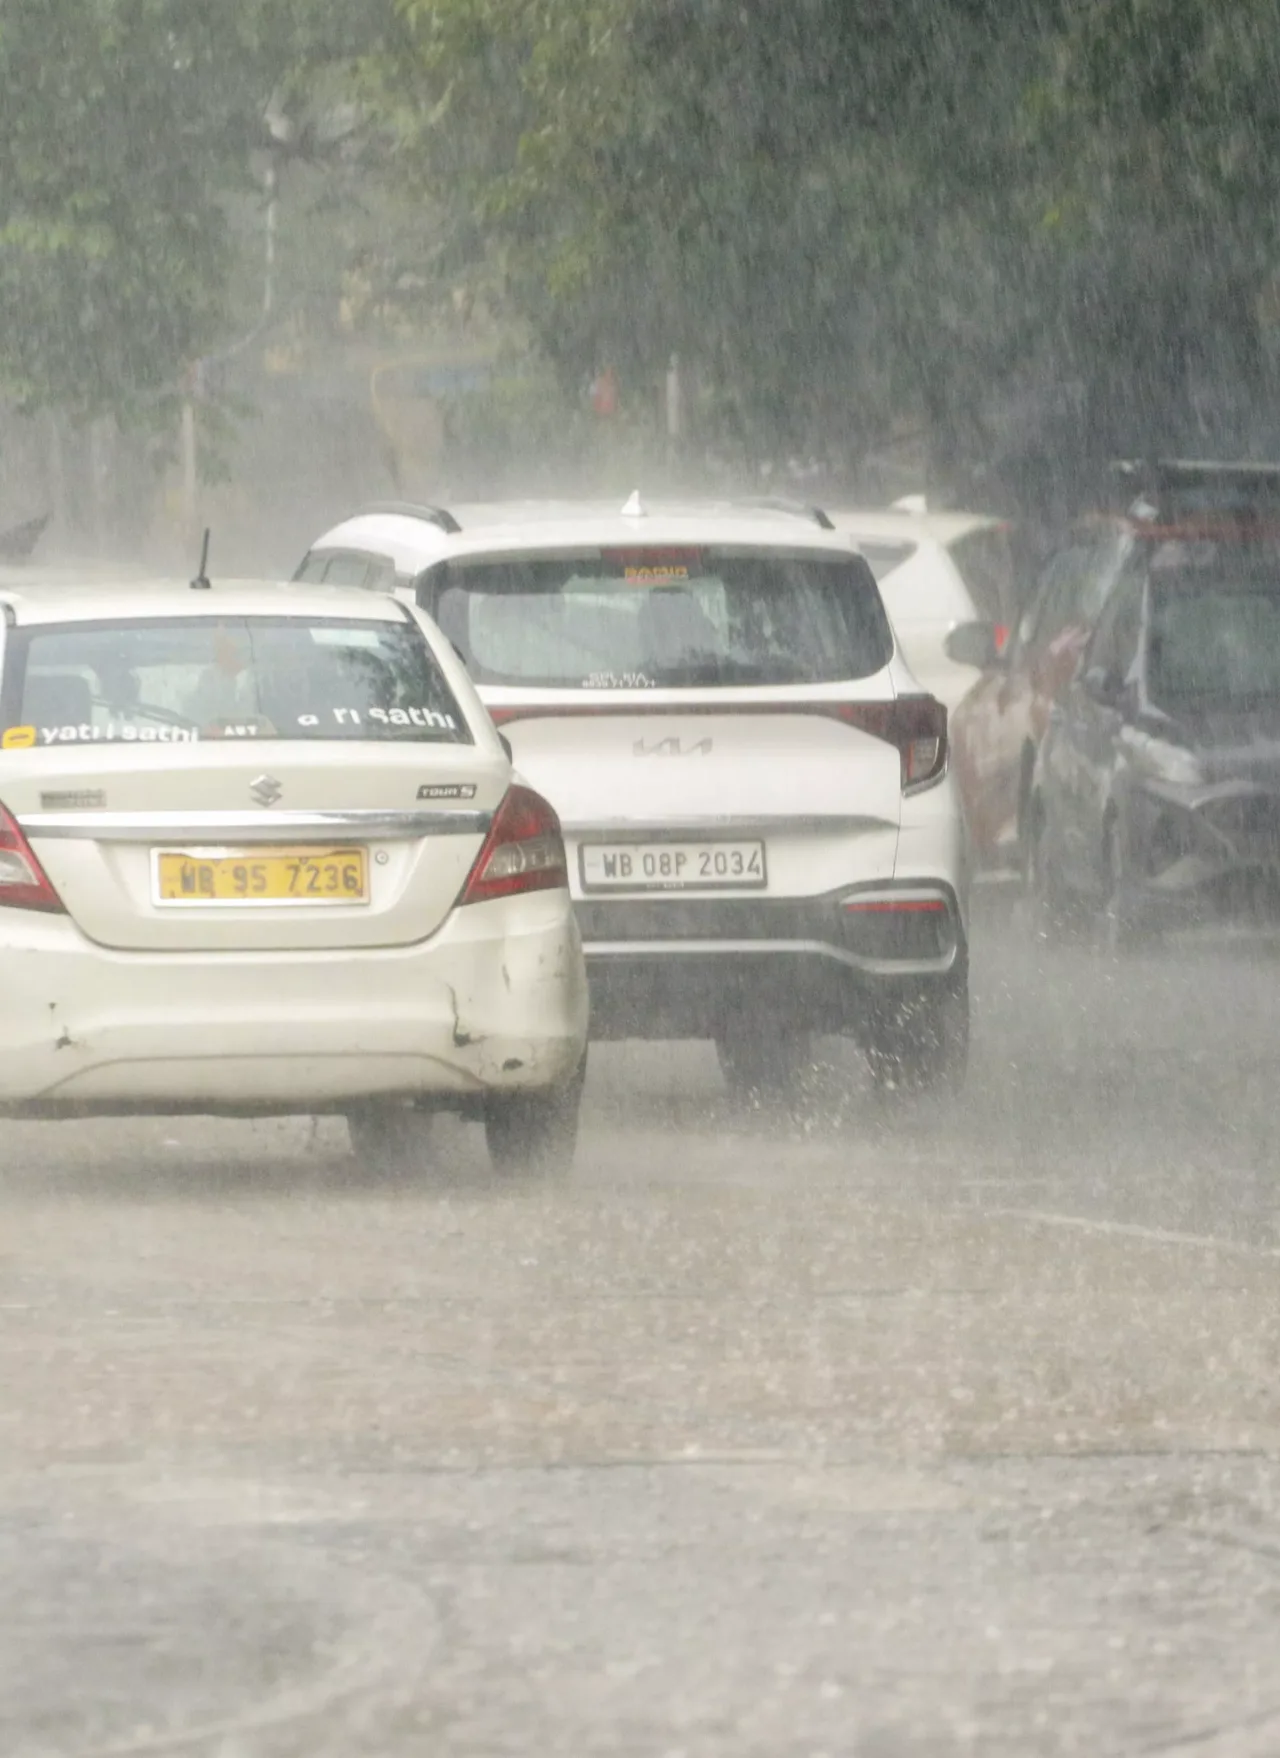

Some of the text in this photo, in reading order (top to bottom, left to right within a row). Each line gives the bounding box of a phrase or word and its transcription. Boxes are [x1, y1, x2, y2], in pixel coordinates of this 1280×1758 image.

[121, 723, 200, 745] sathi
[180, 863, 359, 893] WB 95 7236
[603, 850, 761, 878] WB 08P 2034
